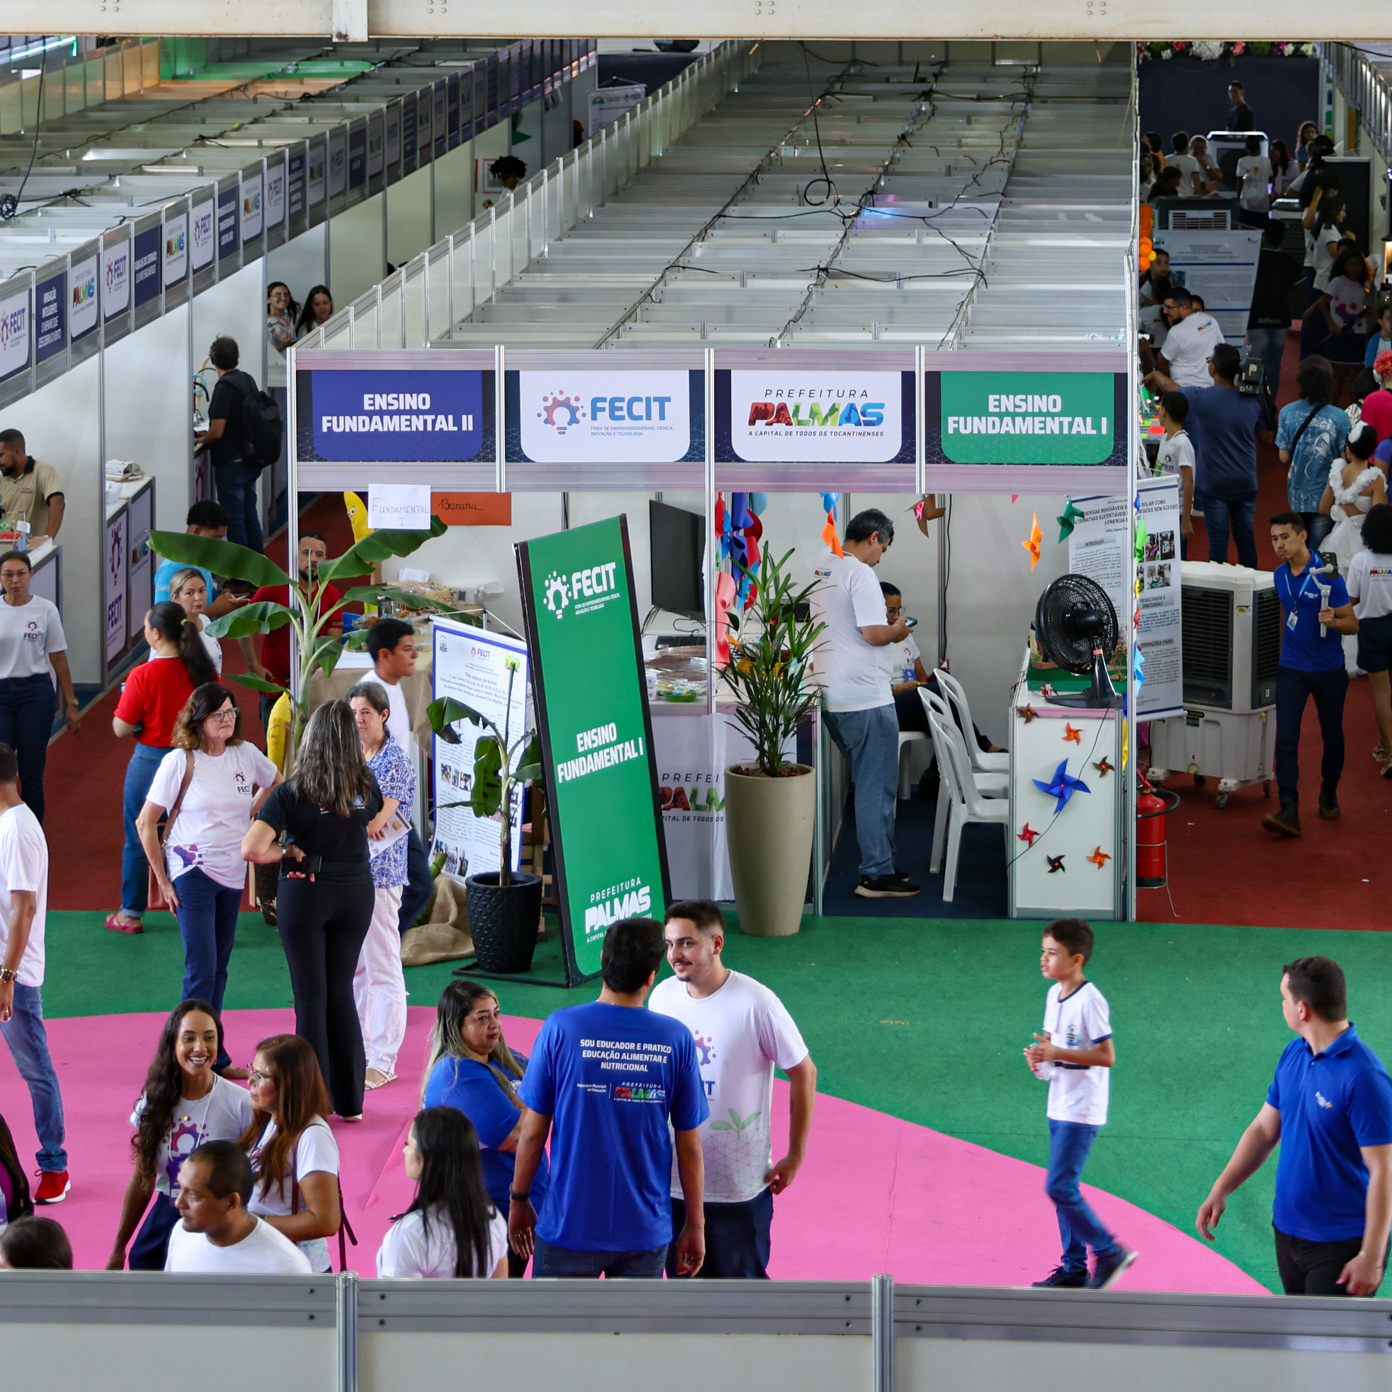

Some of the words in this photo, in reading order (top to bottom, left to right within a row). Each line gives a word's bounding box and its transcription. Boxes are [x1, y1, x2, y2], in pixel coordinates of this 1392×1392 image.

[9, 307, 26, 336] FECIT
[363, 393, 430, 410] ENSINO
[764, 388, 869, 399] PREFEITURA
[590, 396, 672, 421] FECIT
[988, 394, 1062, 413] ENSINO
[321, 414, 458, 433] FUNDAMENTAL
[461, 414, 473, 431] II
[748, 402, 885, 427] PALMAS
[947, 416, 1097, 435] FUNDAMENTAL
[1101, 417, 1107, 434] I
[372, 497, 430, 514] FUNDAMENTAL
[438, 499, 482, 511] Banana
[399, 517, 405, 526] I
[572, 561, 616, 600] FECIT
[477, 648, 491, 658] FECIT
[576, 722, 617, 753] ENSINO
[557, 739, 638, 783] FUNDAMENTAL
[638, 737, 644, 756] I
[662, 773, 726, 783] PREFEI
[660, 786, 726, 811] PALM
[590, 877, 642, 903] PREFEITURA
[585, 885, 651, 934] PALMAS
[580, 1039, 595, 1047] SOU
[596, 1040, 636, 1050] EDUCADOR
[642, 1043, 672, 1054] PRATICO
[582, 1050, 620, 1061] EDUCAÇÃO
[621, 1053, 662, 1063] ALIMENTAR
[662, 1056, 668, 1064] E
[600, 1062, 649, 1072] NUTRICIONAL
